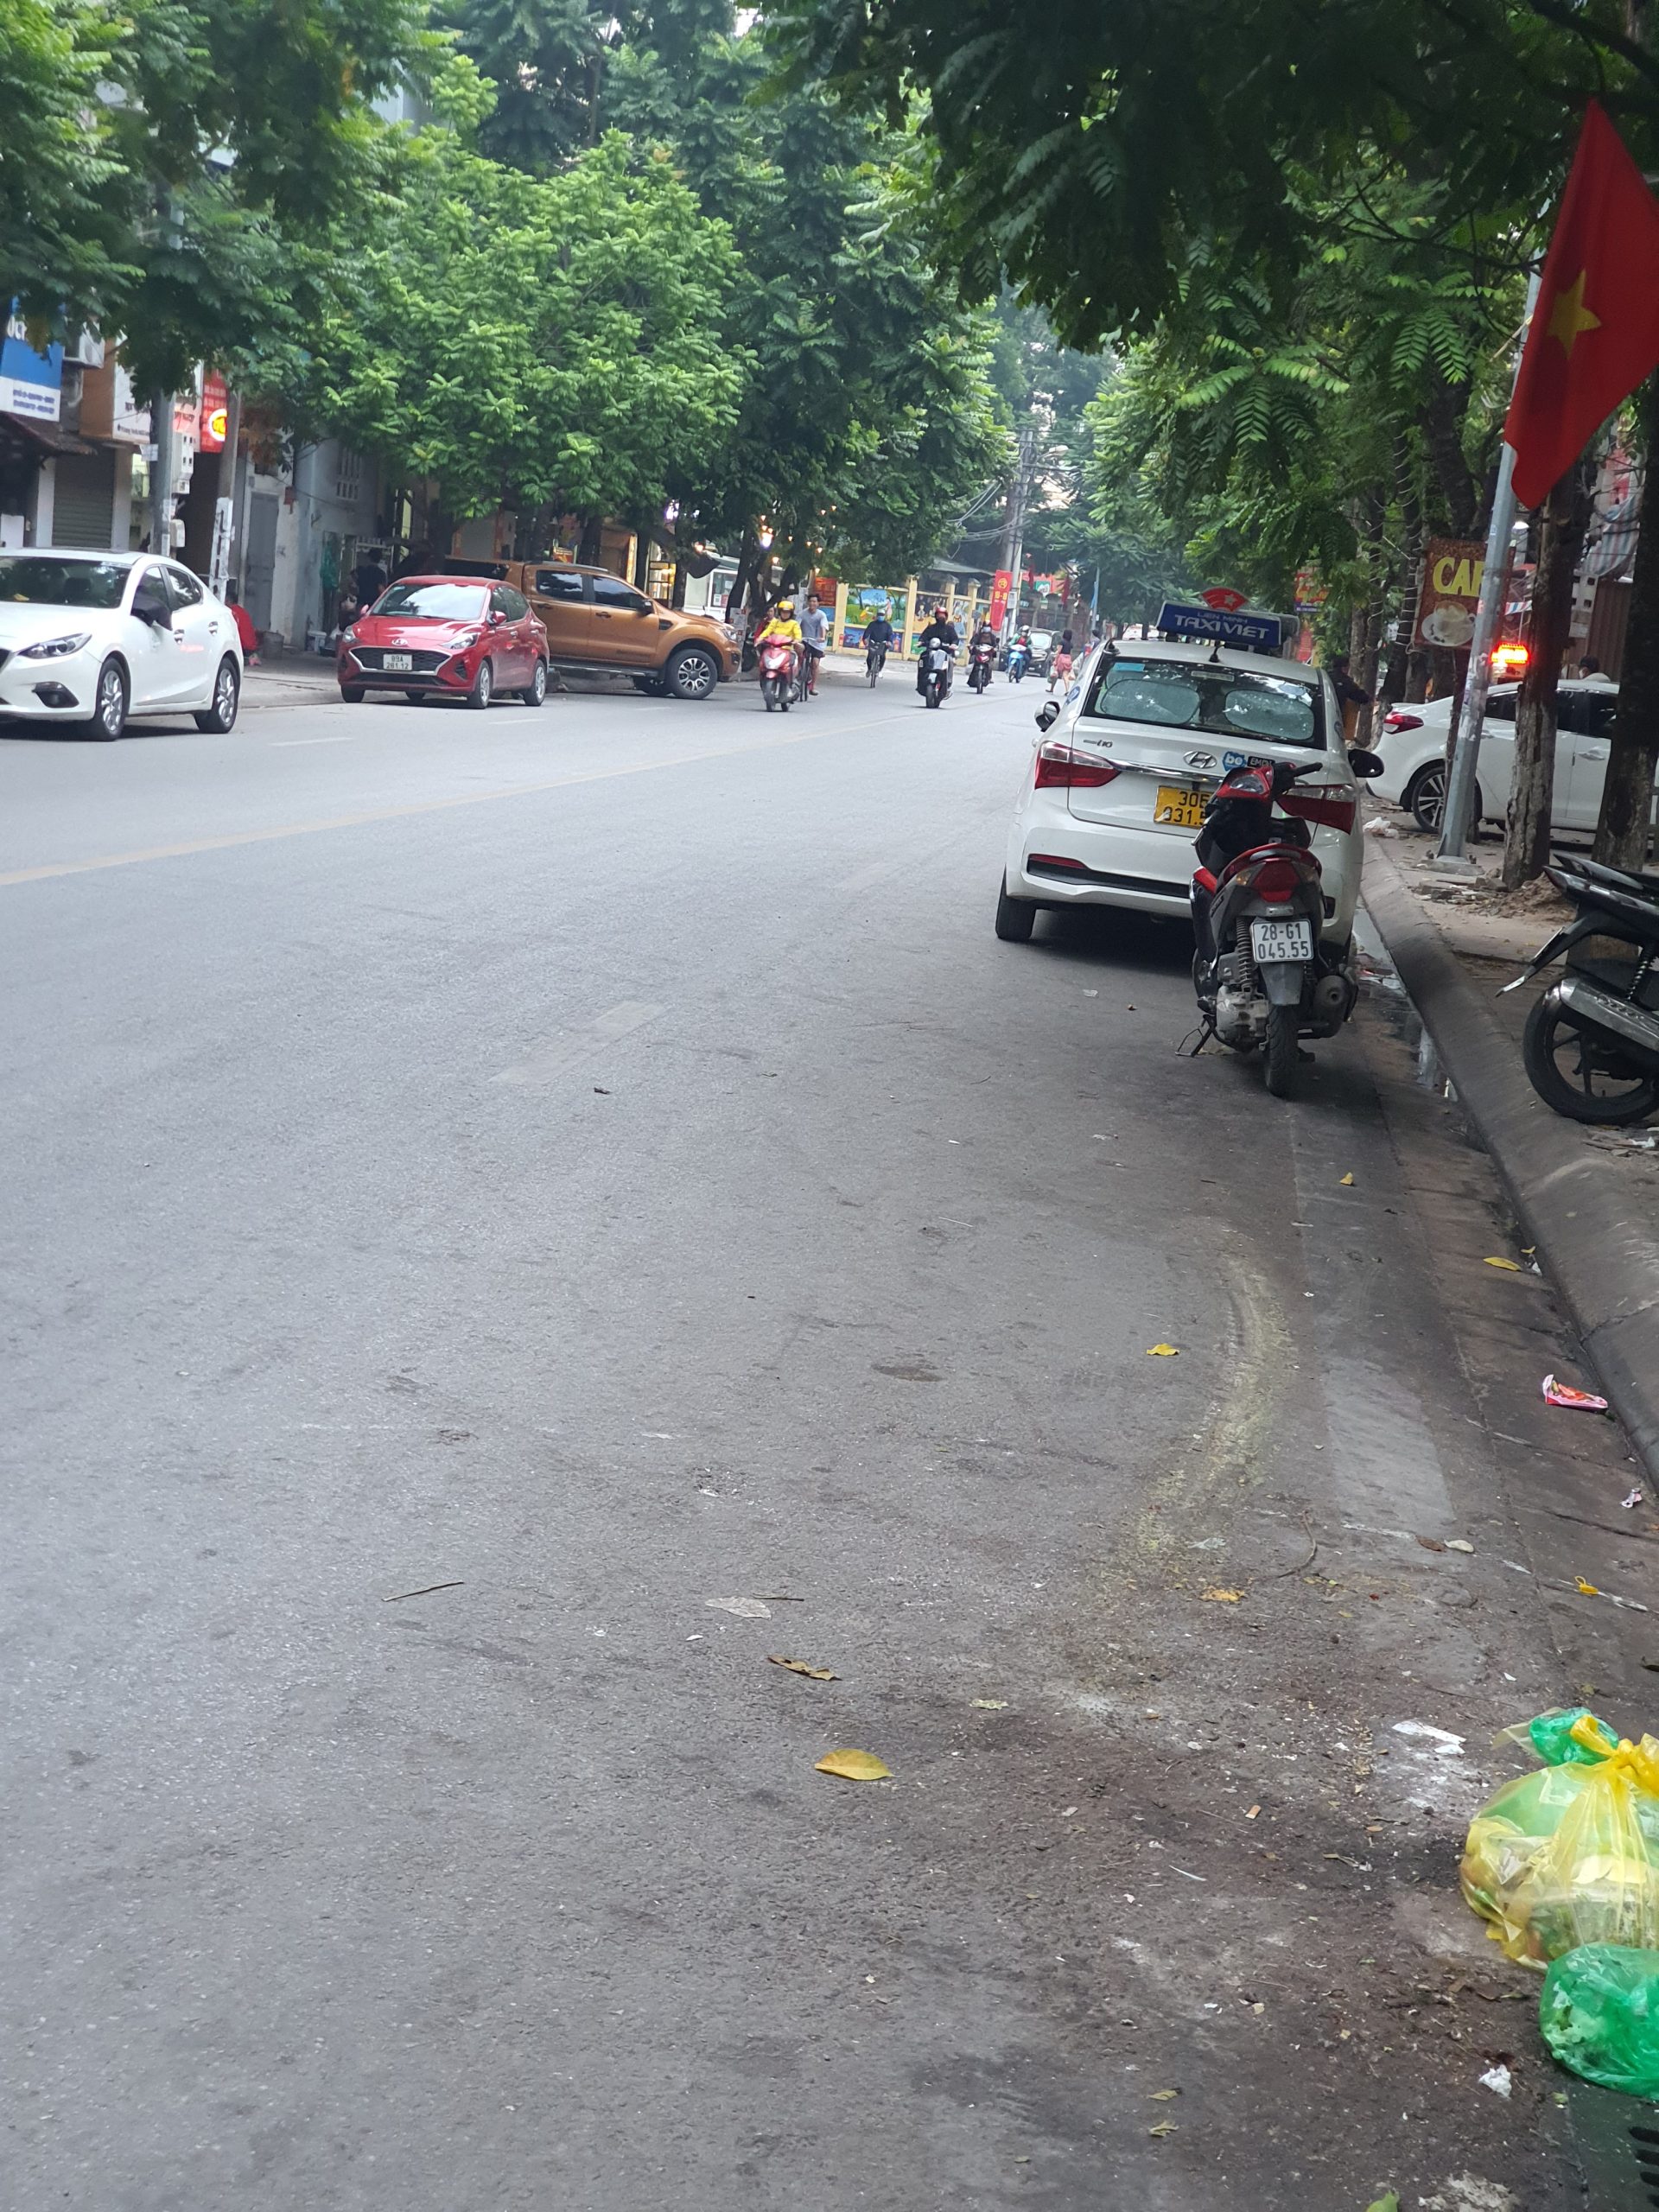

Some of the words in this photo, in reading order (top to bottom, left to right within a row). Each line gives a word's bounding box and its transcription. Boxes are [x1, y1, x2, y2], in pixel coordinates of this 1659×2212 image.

[1433, 556, 1486, 597] CAF
[1174, 614, 1221, 632] TAXI
[1261, 923, 1301, 942] 28-G1
[1257, 940, 1309, 960] 045.55
